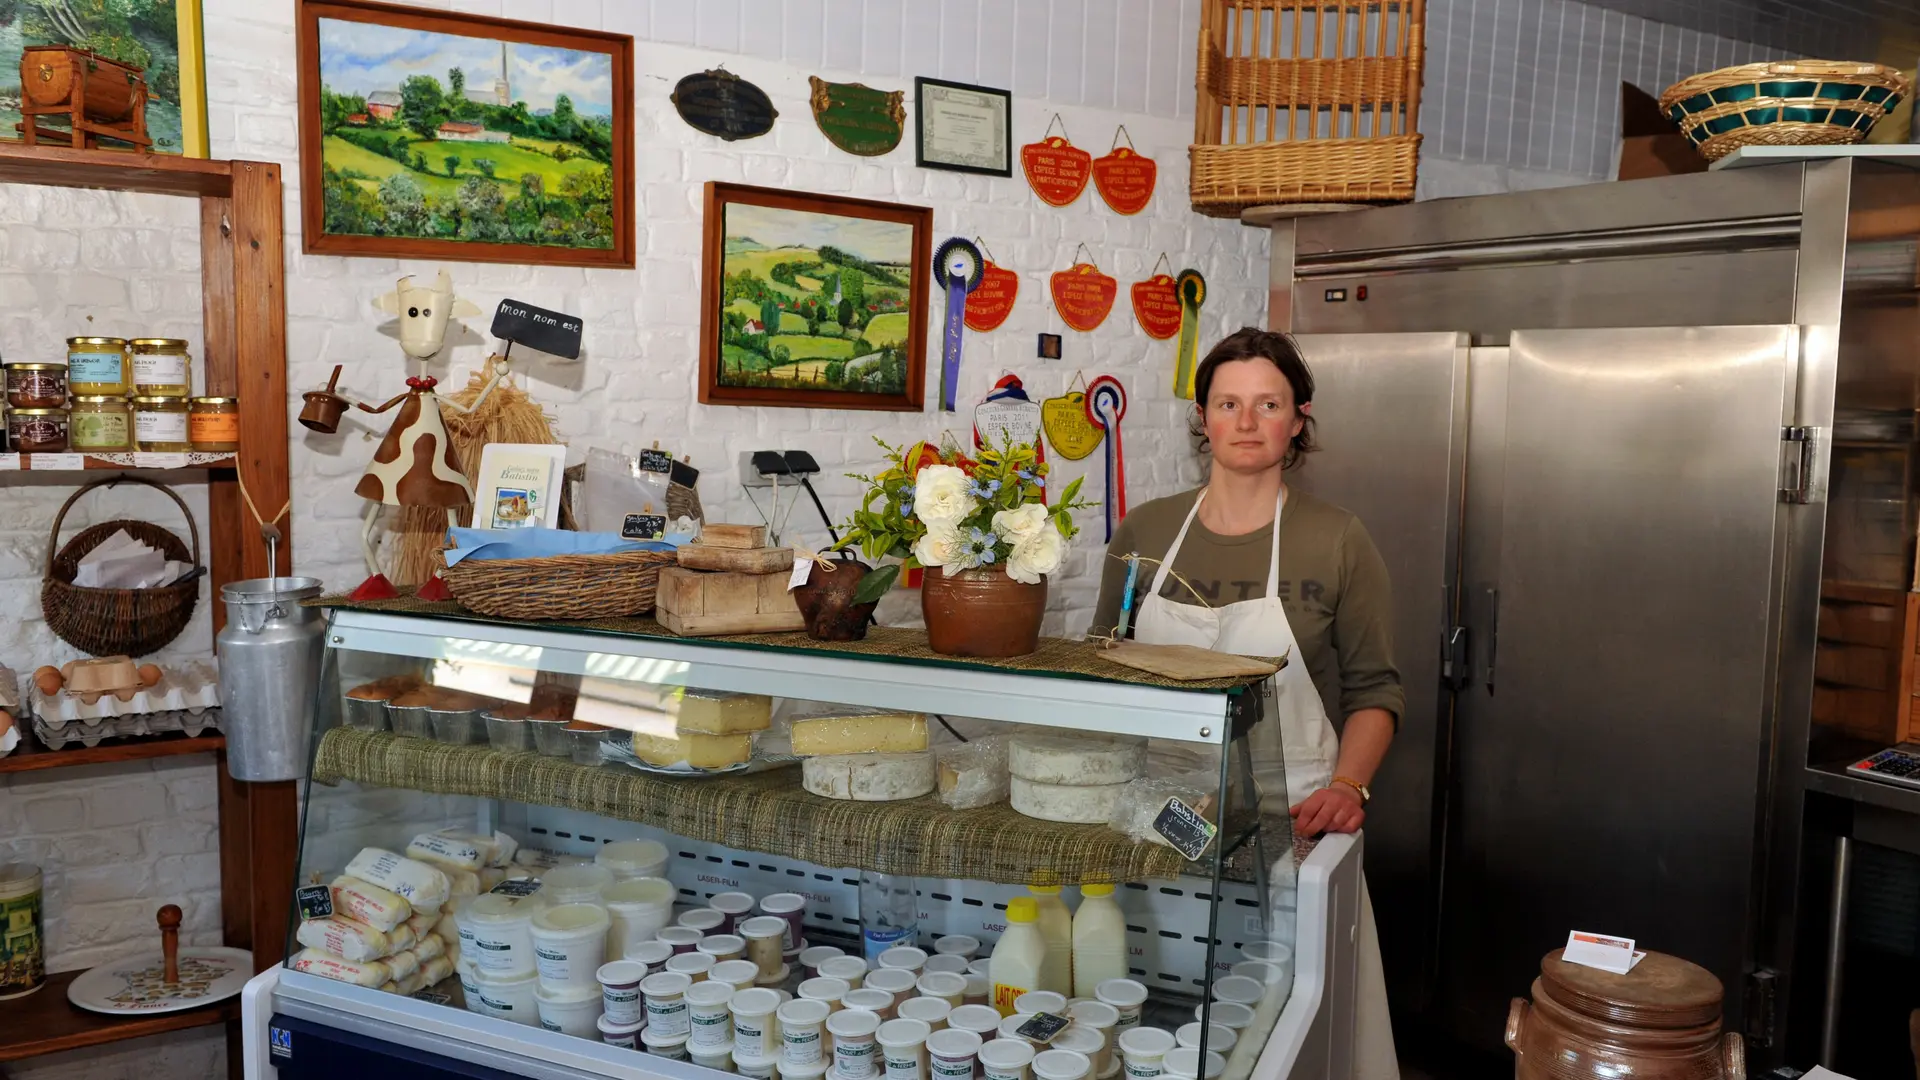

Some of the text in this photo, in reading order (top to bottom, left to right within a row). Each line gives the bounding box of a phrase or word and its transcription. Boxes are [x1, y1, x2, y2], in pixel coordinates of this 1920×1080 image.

[1038, 156, 1055, 165] PARIS
[533, 313, 557, 326] nom
[562, 322, 579, 332] est
[990, 413, 1028, 421] PARIS 2011
[988, 421, 1032, 430] ESPECE BOVINE
[1138, 579, 1325, 603] UNTER
[697, 874, 739, 888] LASER-FILM
[996, 984, 1010, 1007] LAIT
